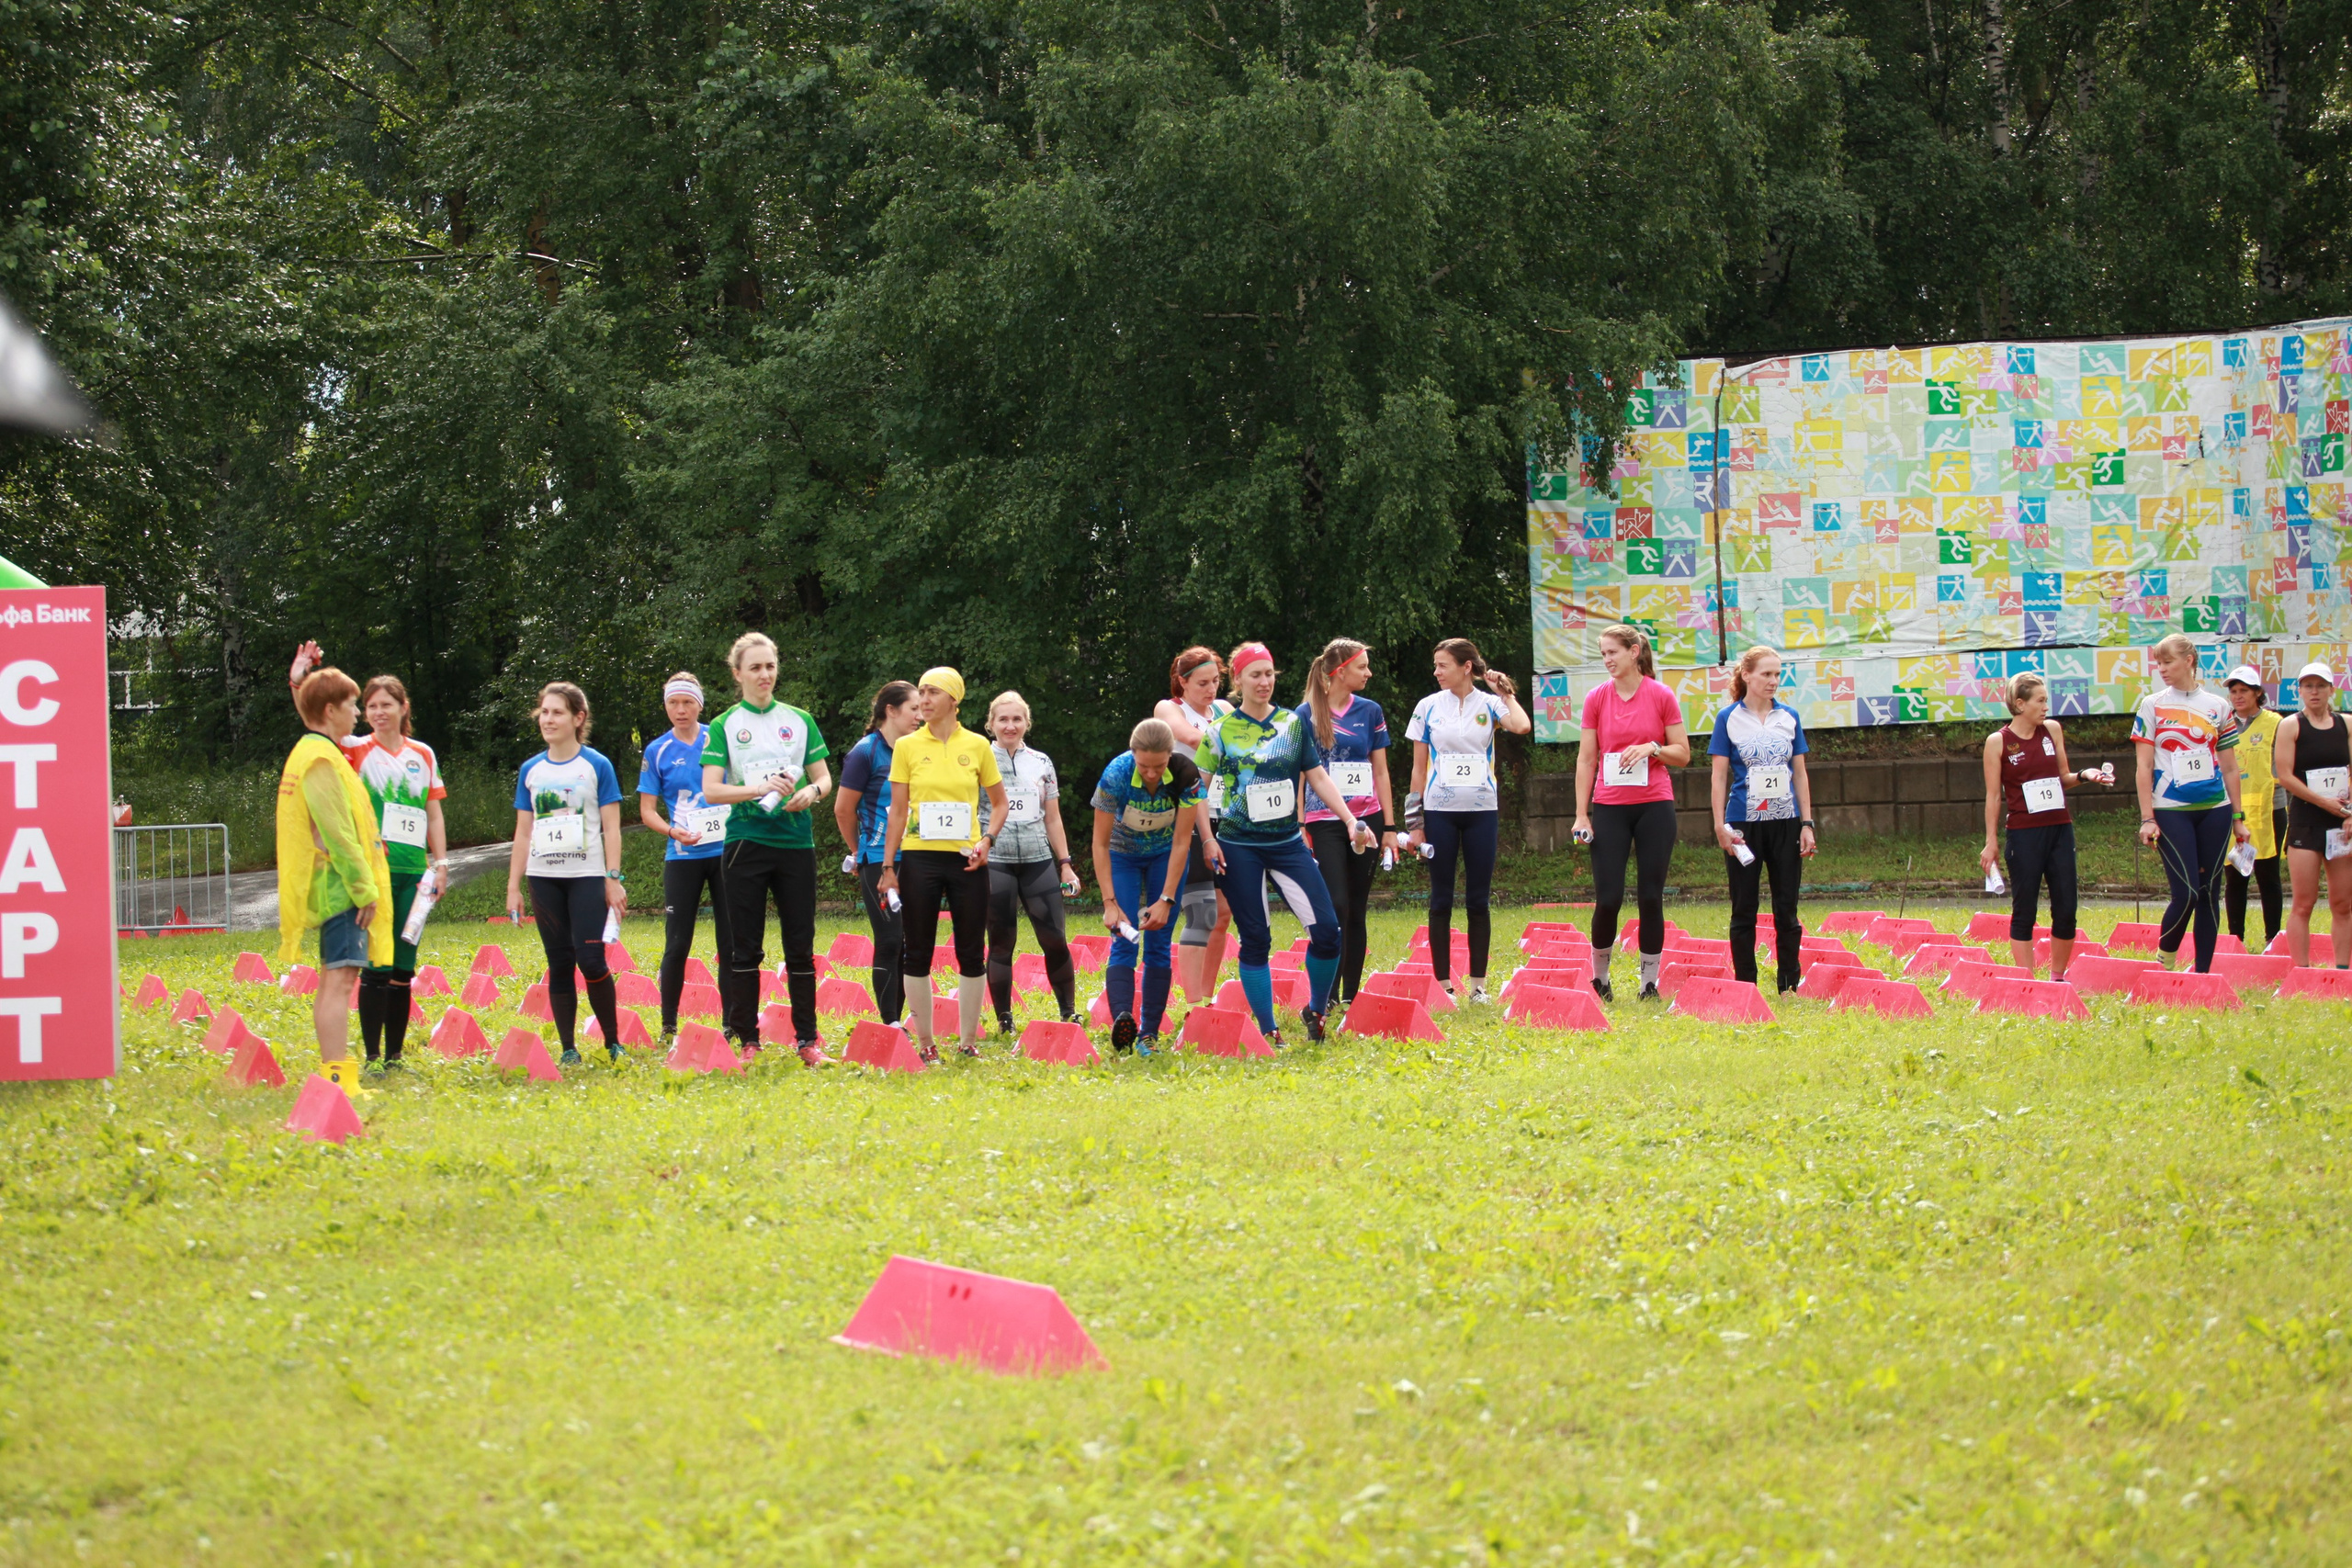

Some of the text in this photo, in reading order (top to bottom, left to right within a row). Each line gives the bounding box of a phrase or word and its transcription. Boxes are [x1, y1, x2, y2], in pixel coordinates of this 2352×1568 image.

[0, 604, 91, 628] фа Банк
[1456, 765, 1471, 776] 23
[2187, 759, 2200, 771] 18
[1347, 773, 1361, 784] 24
[1765, 777, 1778, 788] 21
[2323, 777, 2335, 788] 17
[1216, 780, 1226, 791] 25
[2040, 789, 2052, 800] 19
[1009, 799, 1023, 810] 26
[1266, 795, 1282, 807] 10
[401, 818, 415, 832] 15
[706, 820, 720, 832] 28
[937, 815, 954, 827] 12
[1139, 818, 1153, 827] 11
[548, 829, 563, 842] 14
[0, 660, 67, 1064] СТАРТ
